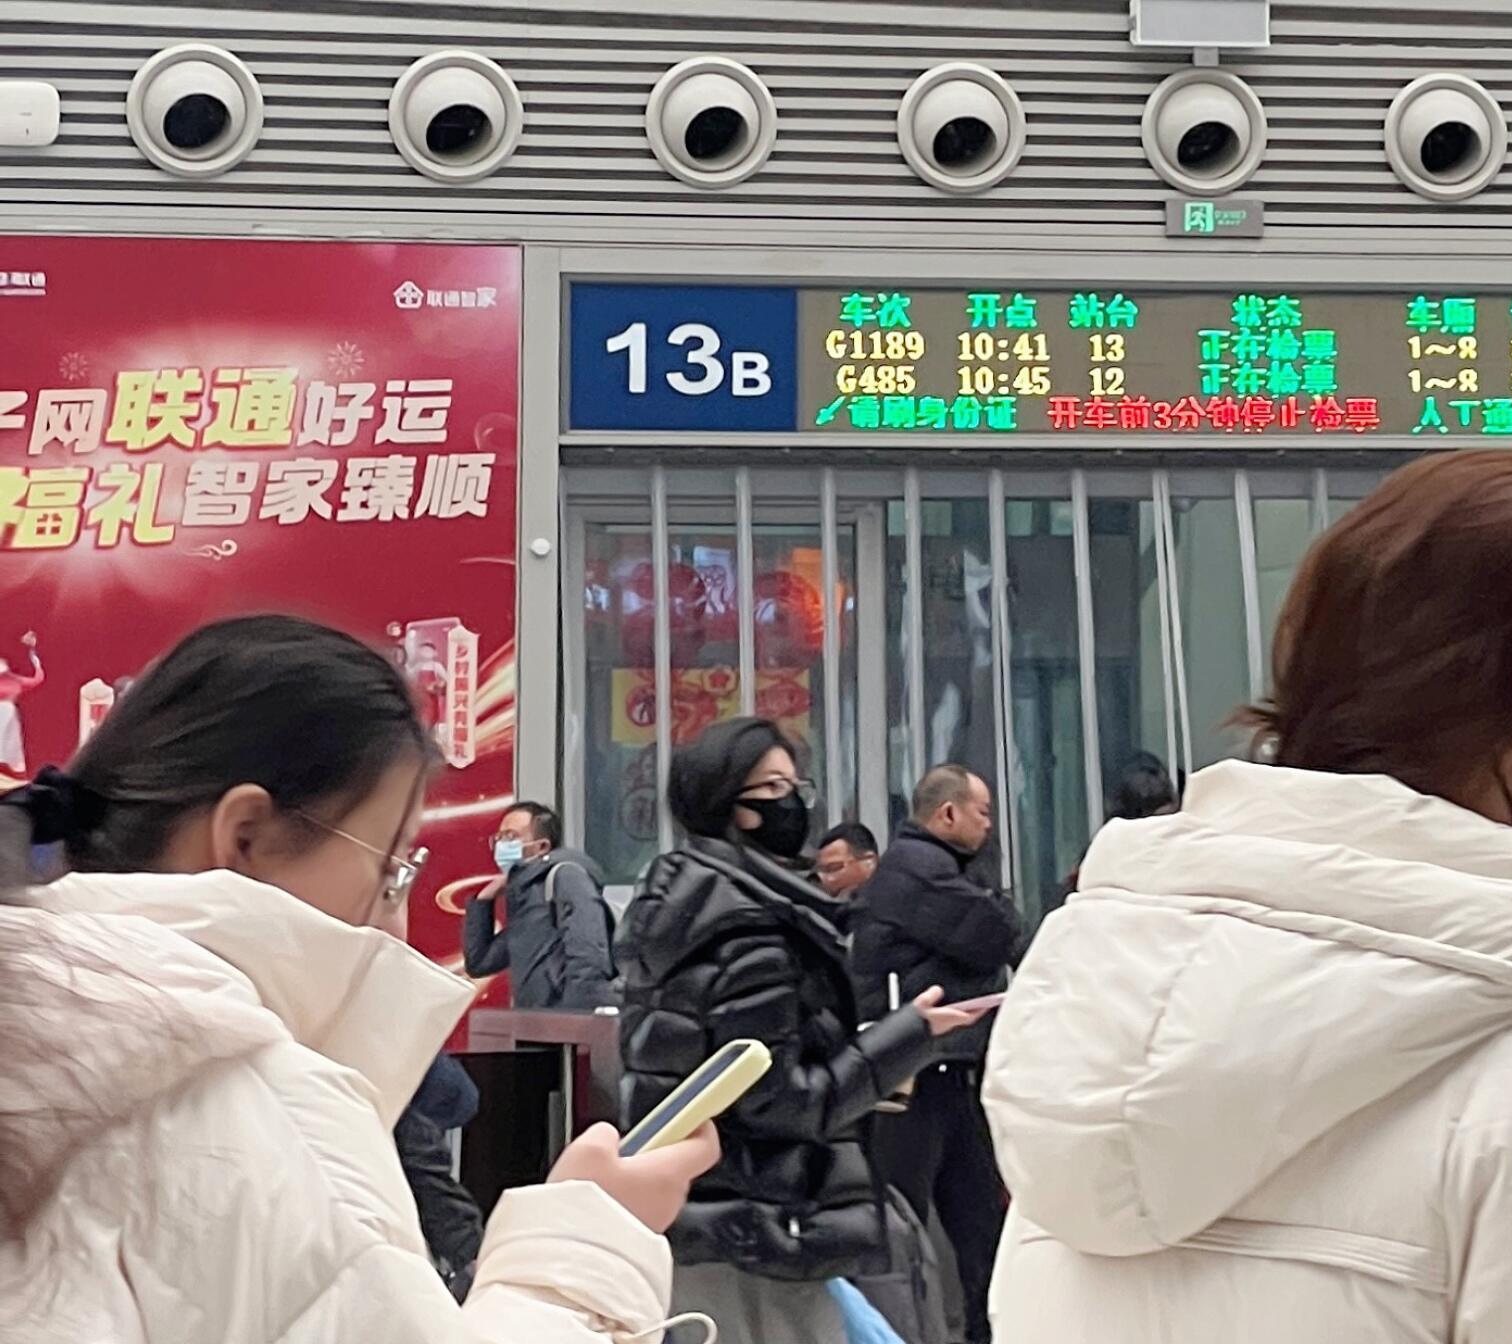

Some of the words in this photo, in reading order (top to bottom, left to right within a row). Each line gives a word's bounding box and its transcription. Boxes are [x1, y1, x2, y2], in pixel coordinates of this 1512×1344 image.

[840, 293, 911, 328] 车次
[966, 293, 1037, 329] 开点
[1069, 293, 1139, 328] 站台
[1232, 294, 1302, 332] 状态
[1406, 296, 1476, 333] 车厢
[605, 322, 772, 396] 13B
[826, 330, 925, 360] G1189
[957, 332, 1050, 361] 10:41
[1089, 334, 1125, 362] 13
[1198, 328, 1338, 365] 正在检票
[836, 365, 916, 394] G485
[958, 366, 1050, 395] 10:45
[1089, 367, 1125, 396] 12
[1198, 362, 1338, 399] 正在检票
[847, 395, 1017, 430] 请刷身份证
[1047, 394, 1381, 433] 开车前3分钟停止检票
